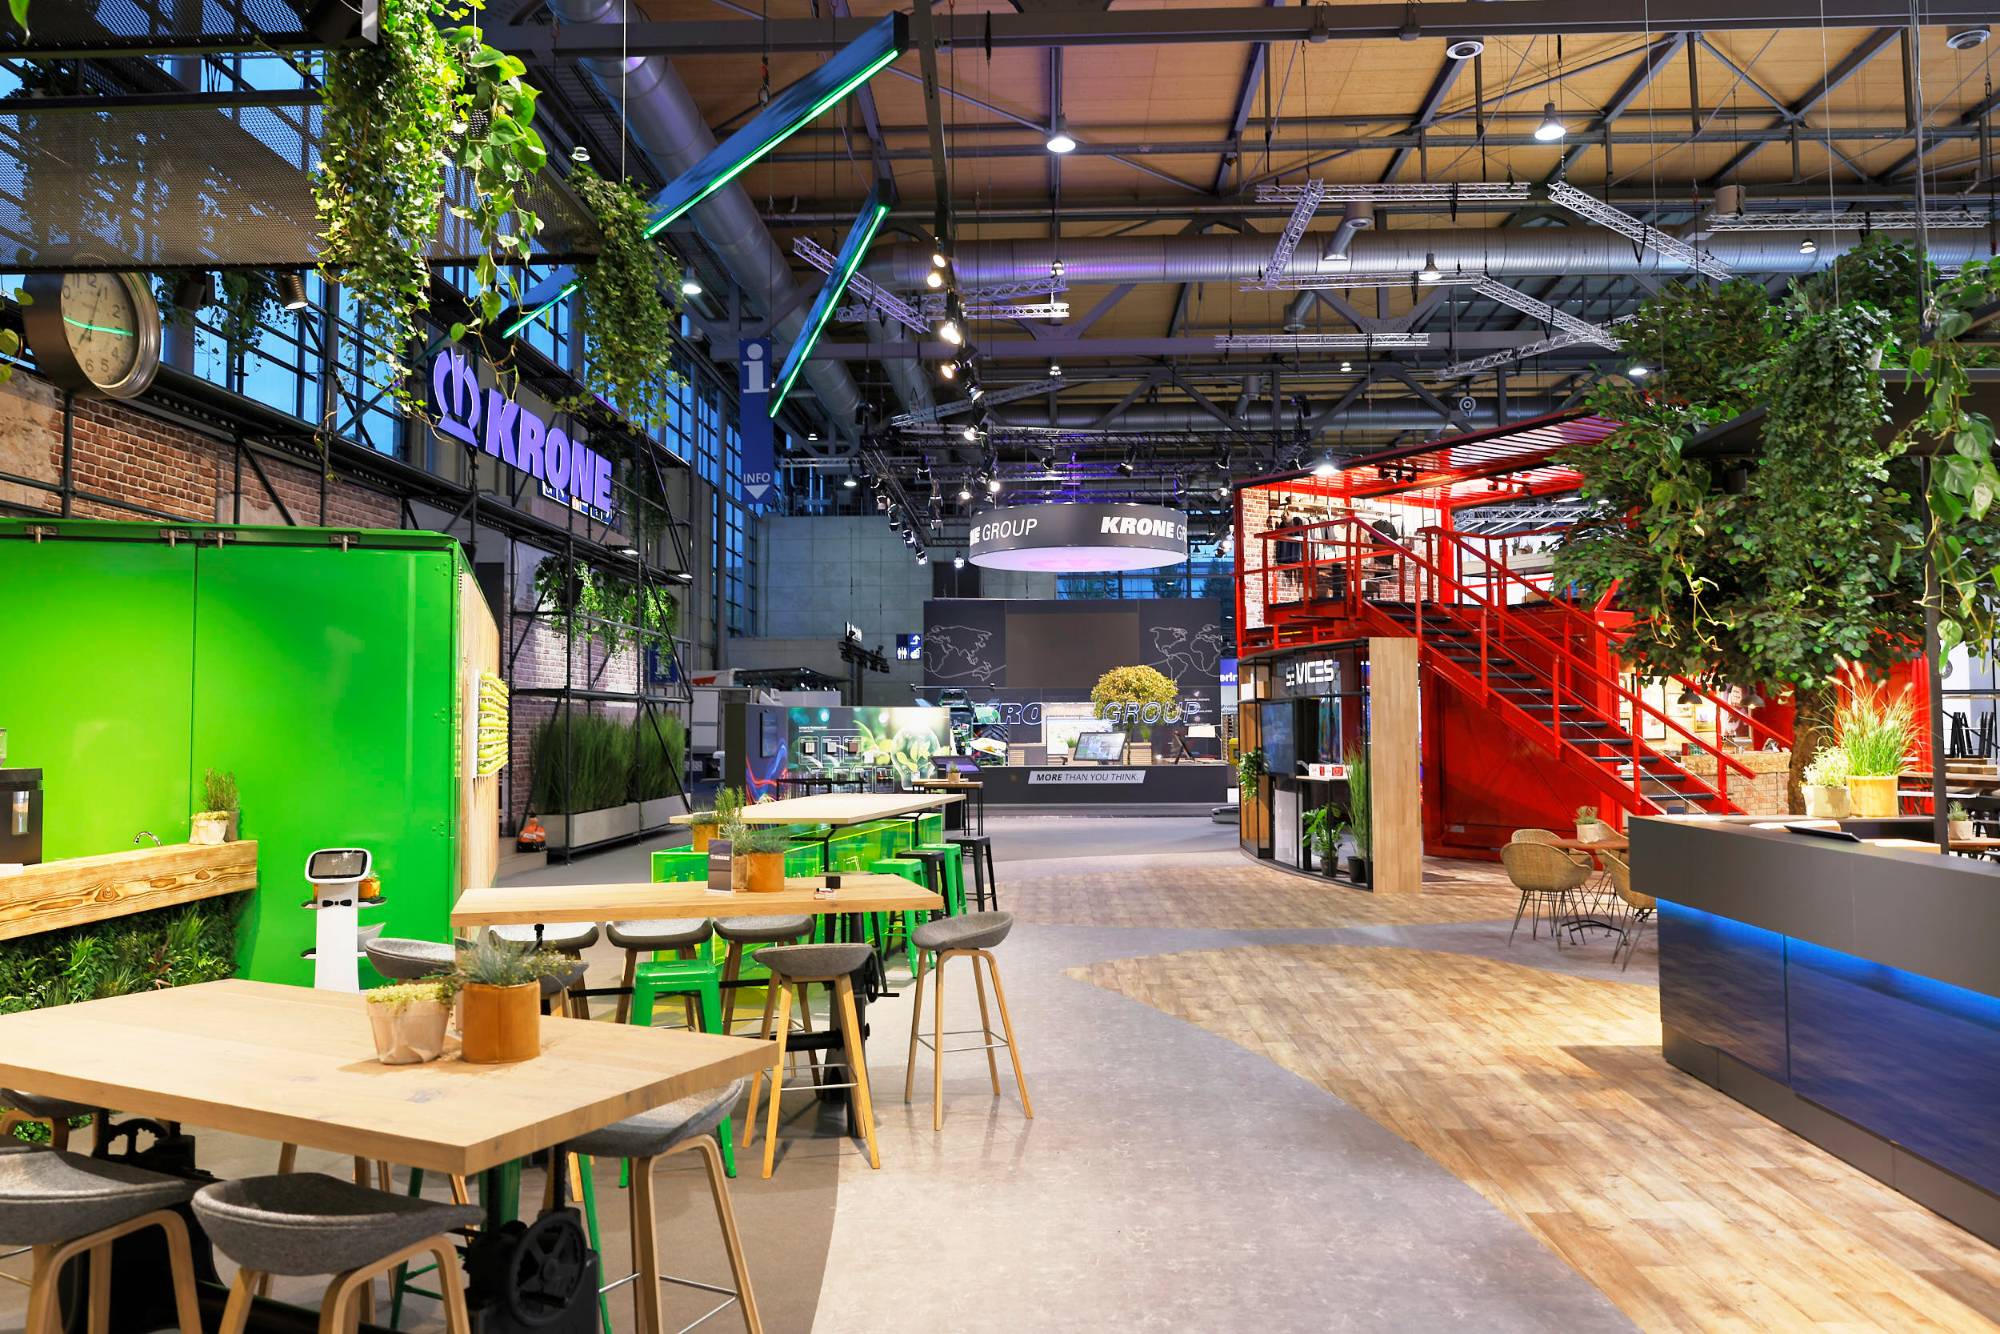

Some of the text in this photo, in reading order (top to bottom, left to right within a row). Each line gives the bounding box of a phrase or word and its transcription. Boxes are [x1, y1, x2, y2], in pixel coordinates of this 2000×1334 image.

[87, 274, 97, 289] 12
[112, 304, 121, 319] 2
[111, 346, 120, 360] 4
[85, 357, 94, 373] 6
[100, 357, 109, 373] 5
[485, 387, 613, 514] KRONE
[743, 472, 771, 484] INFO
[982, 518, 1038, 541] GROUP
[1100, 516, 1175, 539] KRONE
[1103, 701, 1201, 724] GROUP
[1036, 773, 1063, 782] MORE
[1065, 773, 1088, 782] THAN
[1090, 773, 1109, 782] YOU
